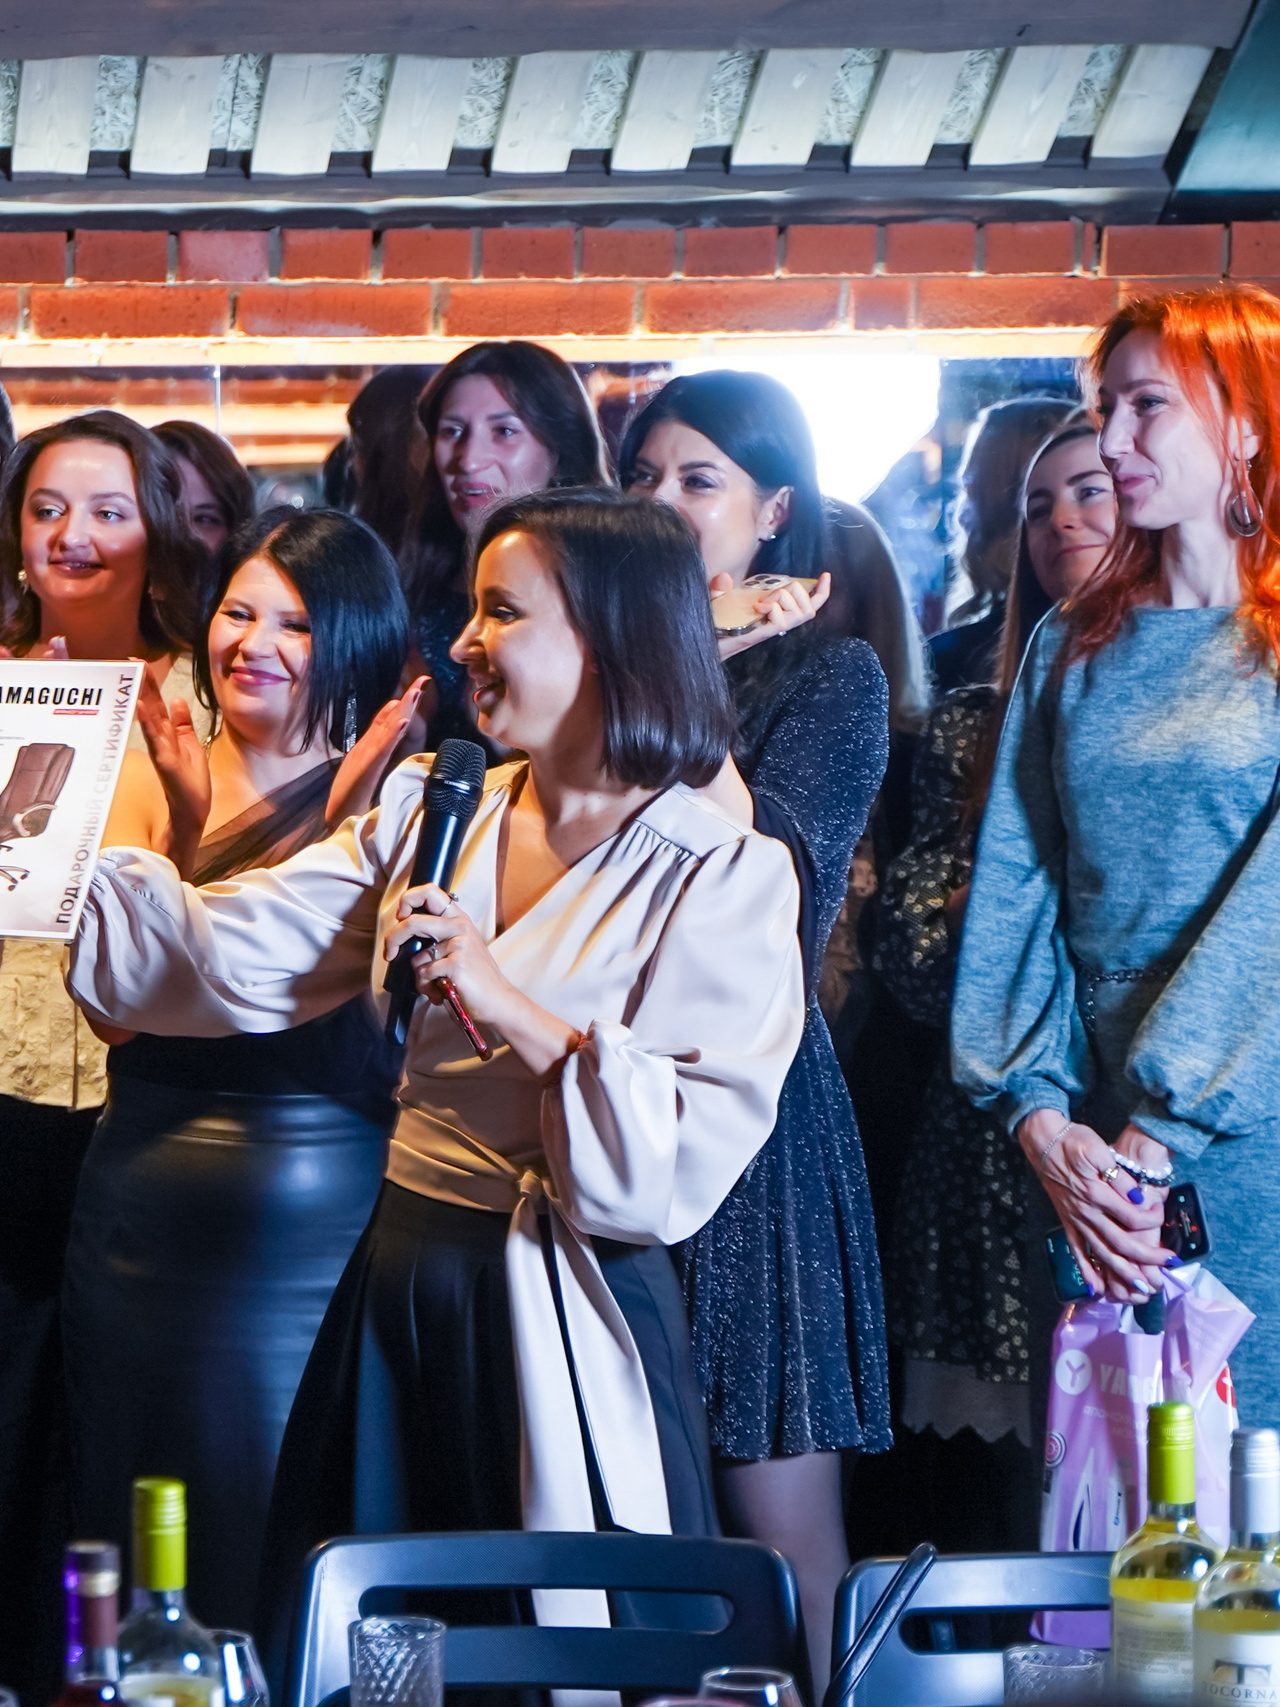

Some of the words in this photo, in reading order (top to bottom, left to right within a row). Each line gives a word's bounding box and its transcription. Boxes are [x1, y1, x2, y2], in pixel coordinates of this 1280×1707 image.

[55, 799, 104, 925] ПОДАРОЧНЫЙ
[94, 673, 134, 796] СЕРТИФИКАТ
[1202, 1681, 1277, 1700] TOCORNA
